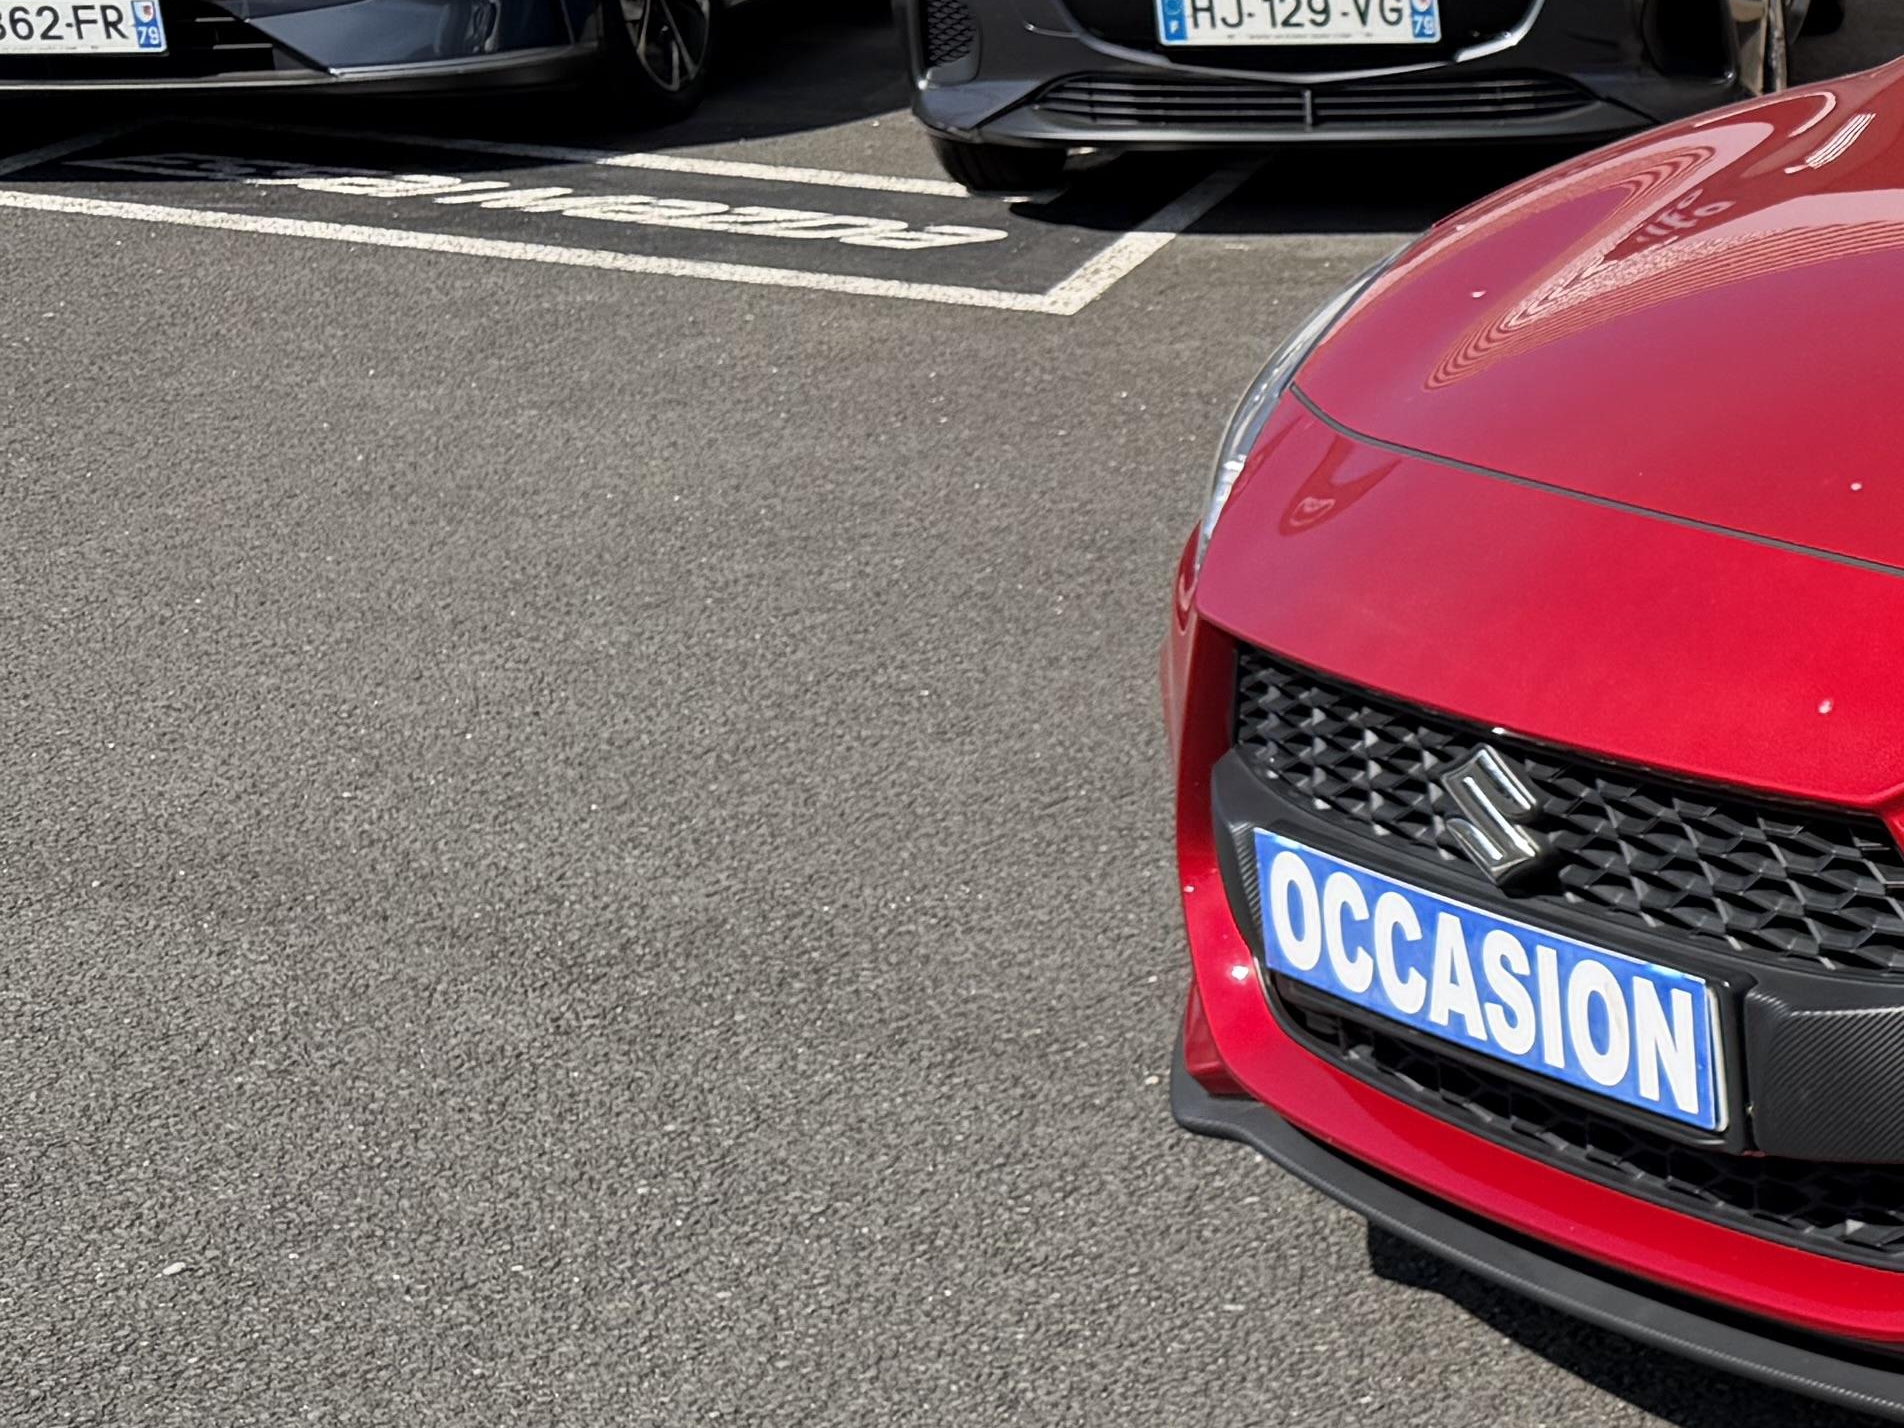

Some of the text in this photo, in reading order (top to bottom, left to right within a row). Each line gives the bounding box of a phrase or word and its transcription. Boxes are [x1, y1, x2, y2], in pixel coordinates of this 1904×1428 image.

[137, 26, 160, 45] 79
[1412, 15, 1434, 36] 79
[1265, 849, 1703, 1116] OCCASION
